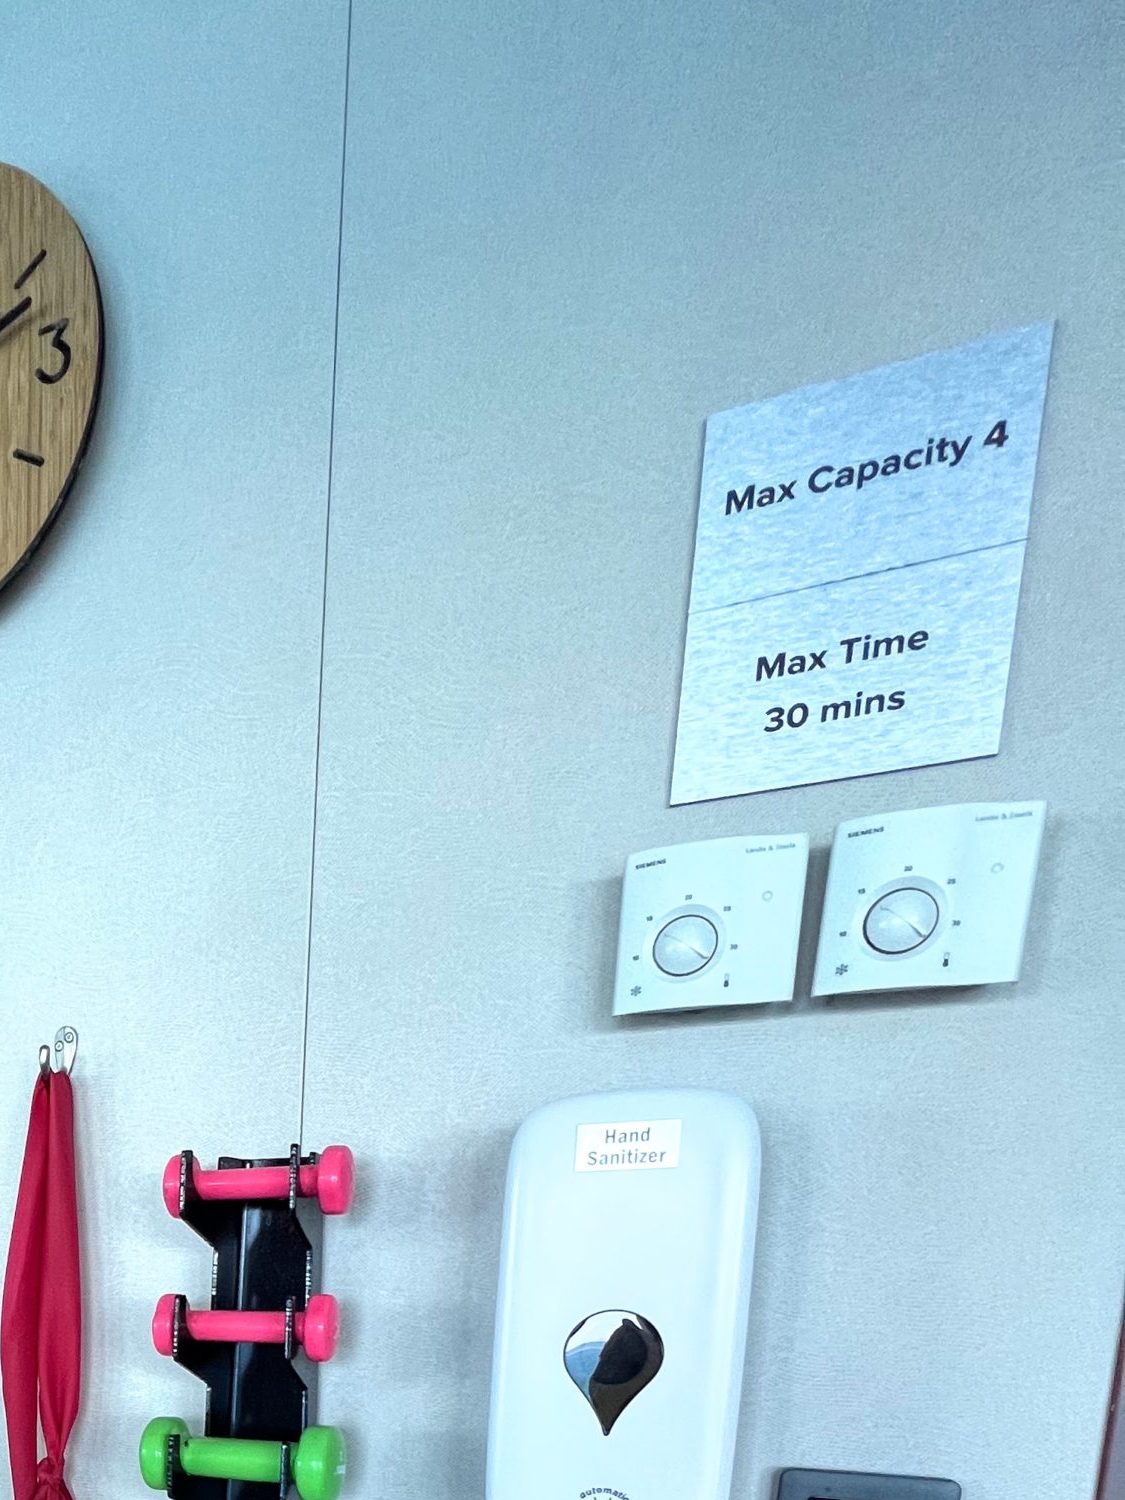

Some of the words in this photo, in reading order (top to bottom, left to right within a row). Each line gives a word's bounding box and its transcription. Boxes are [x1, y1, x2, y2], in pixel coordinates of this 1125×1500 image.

[36, 318, 72, 384] 3
[724, 479, 796, 515] Max
[808, 434, 972, 494] Capacity
[983, 419, 1008, 449] 4
[755, 648, 826, 682] Max
[840, 627, 929, 665] Time
[763, 702, 809, 733] 30
[820, 687, 905, 723] mins
[848, 826, 884, 839] SIEMENS
[635, 858, 667, 870] SIEMENS
[605, 1127, 651, 1144] Hand
[587, 1148, 667, 1166] Sanitizer
